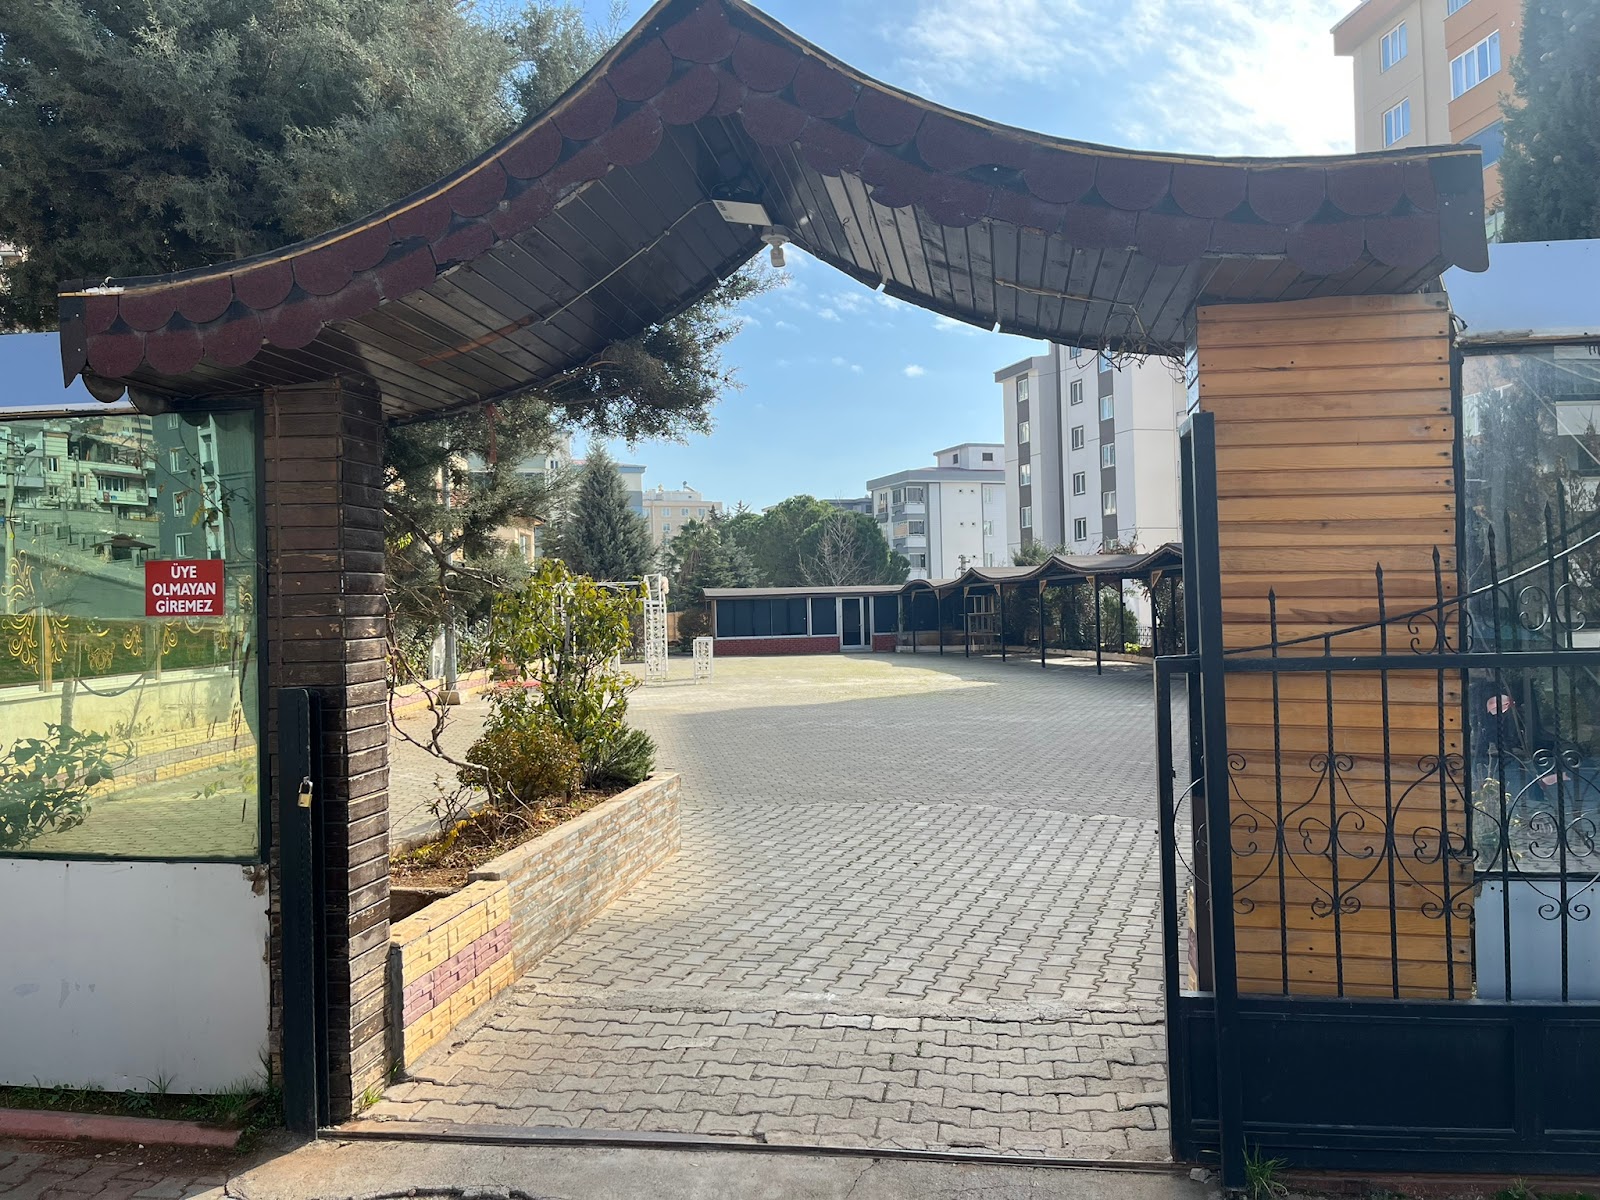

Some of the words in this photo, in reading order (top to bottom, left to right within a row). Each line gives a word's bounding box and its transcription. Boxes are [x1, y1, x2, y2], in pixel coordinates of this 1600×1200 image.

[171, 563, 197, 578] ÜYE
[152, 582, 216, 596] OLMAYAN
[155, 597, 213, 613] GİREMEZ
